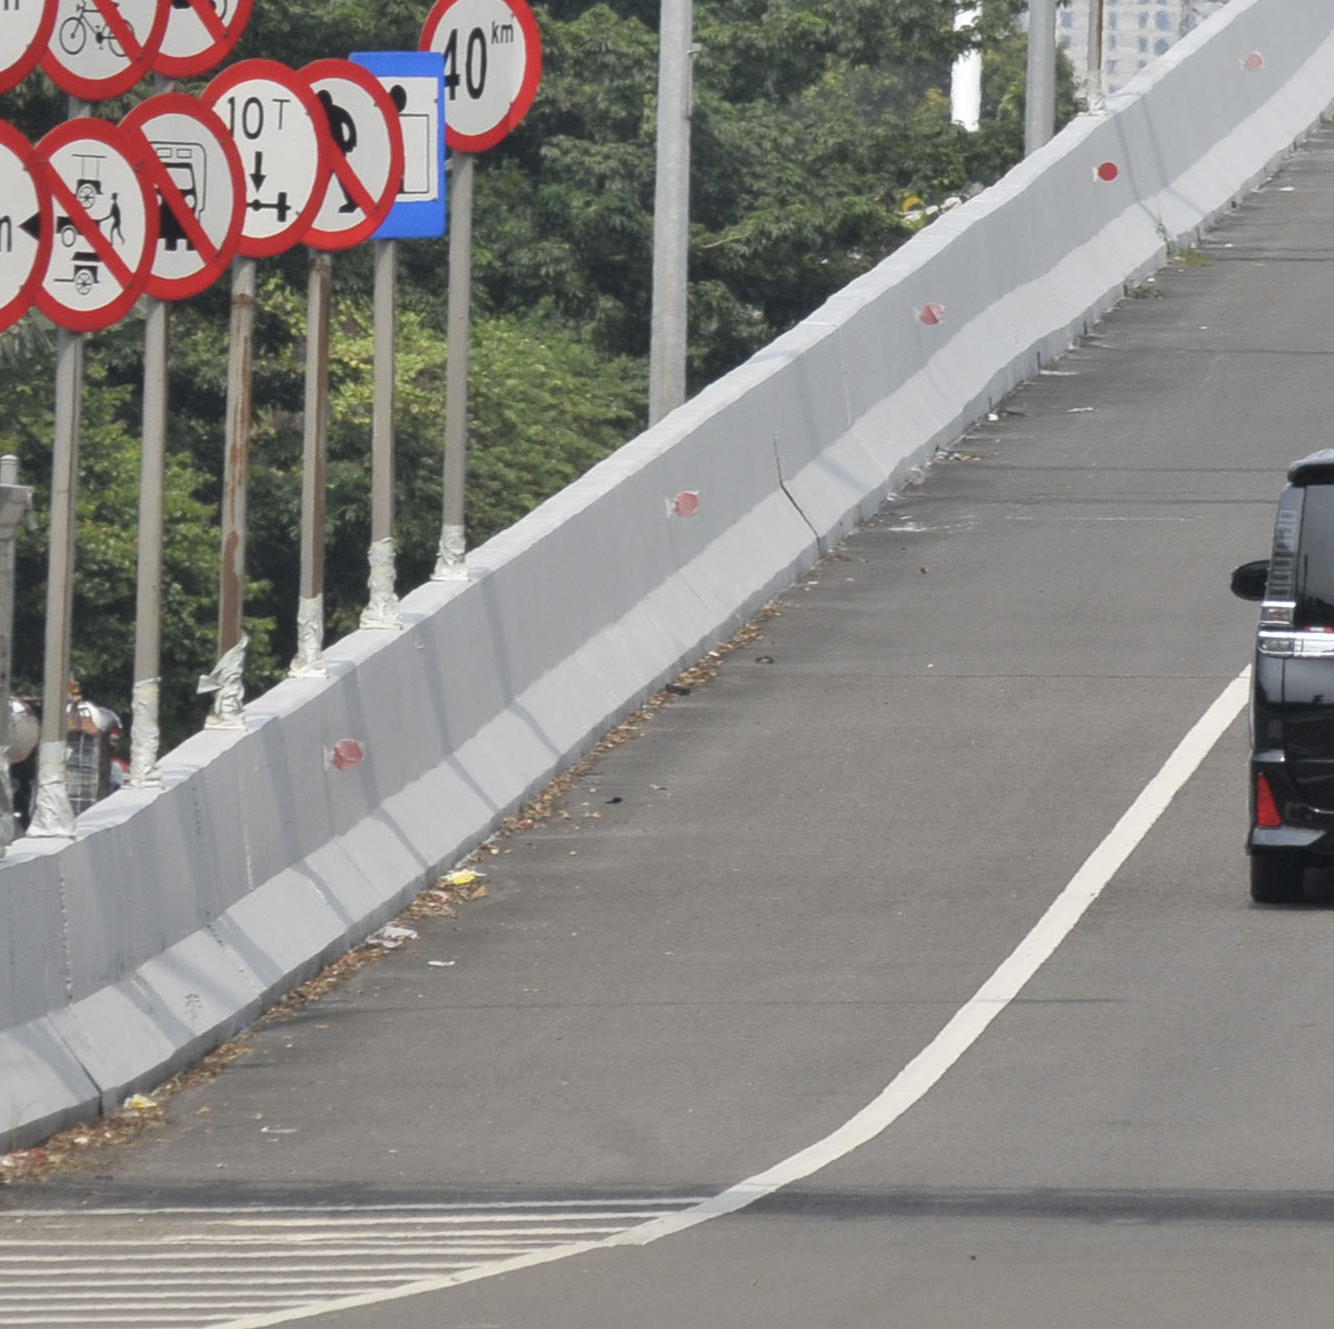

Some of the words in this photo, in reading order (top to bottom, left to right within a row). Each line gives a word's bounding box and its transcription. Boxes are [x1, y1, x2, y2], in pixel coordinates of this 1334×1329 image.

[444, 27, 487, 101] 40
[491, 21, 515, 45] km
[228, 96, 264, 140] 10
[272, 98, 291, 130] T
